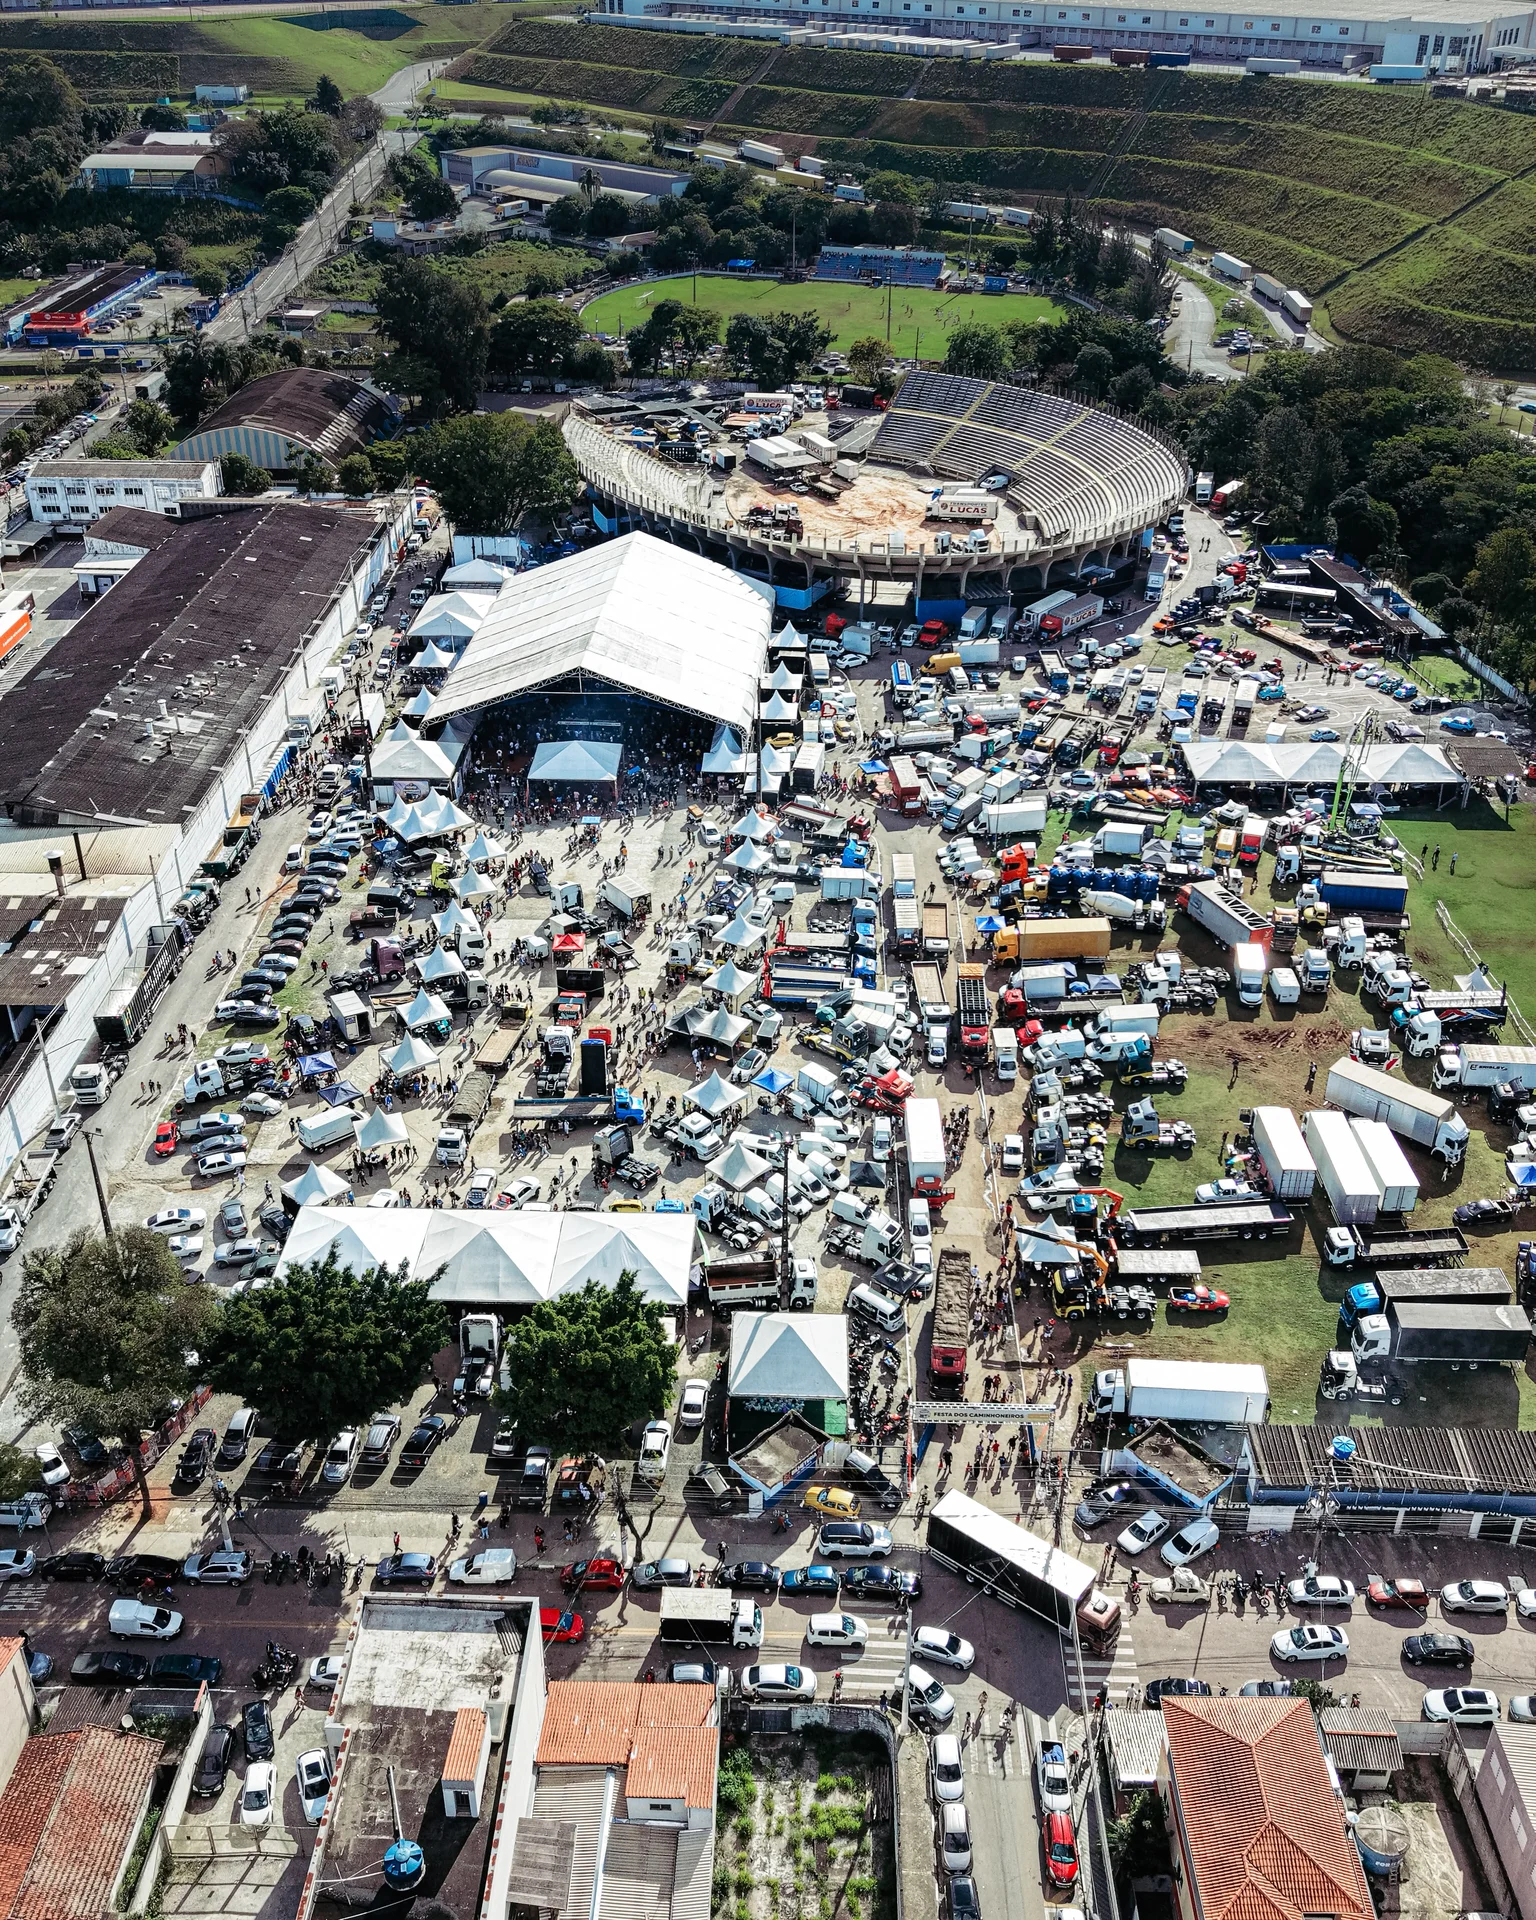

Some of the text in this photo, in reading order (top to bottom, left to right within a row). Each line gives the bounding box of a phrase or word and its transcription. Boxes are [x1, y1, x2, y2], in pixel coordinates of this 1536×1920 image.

[807, 443, 823, 457] LUCAS
[949, 506, 988, 514] LUCAS
[1069, 608, 1097, 625] LUCAS
